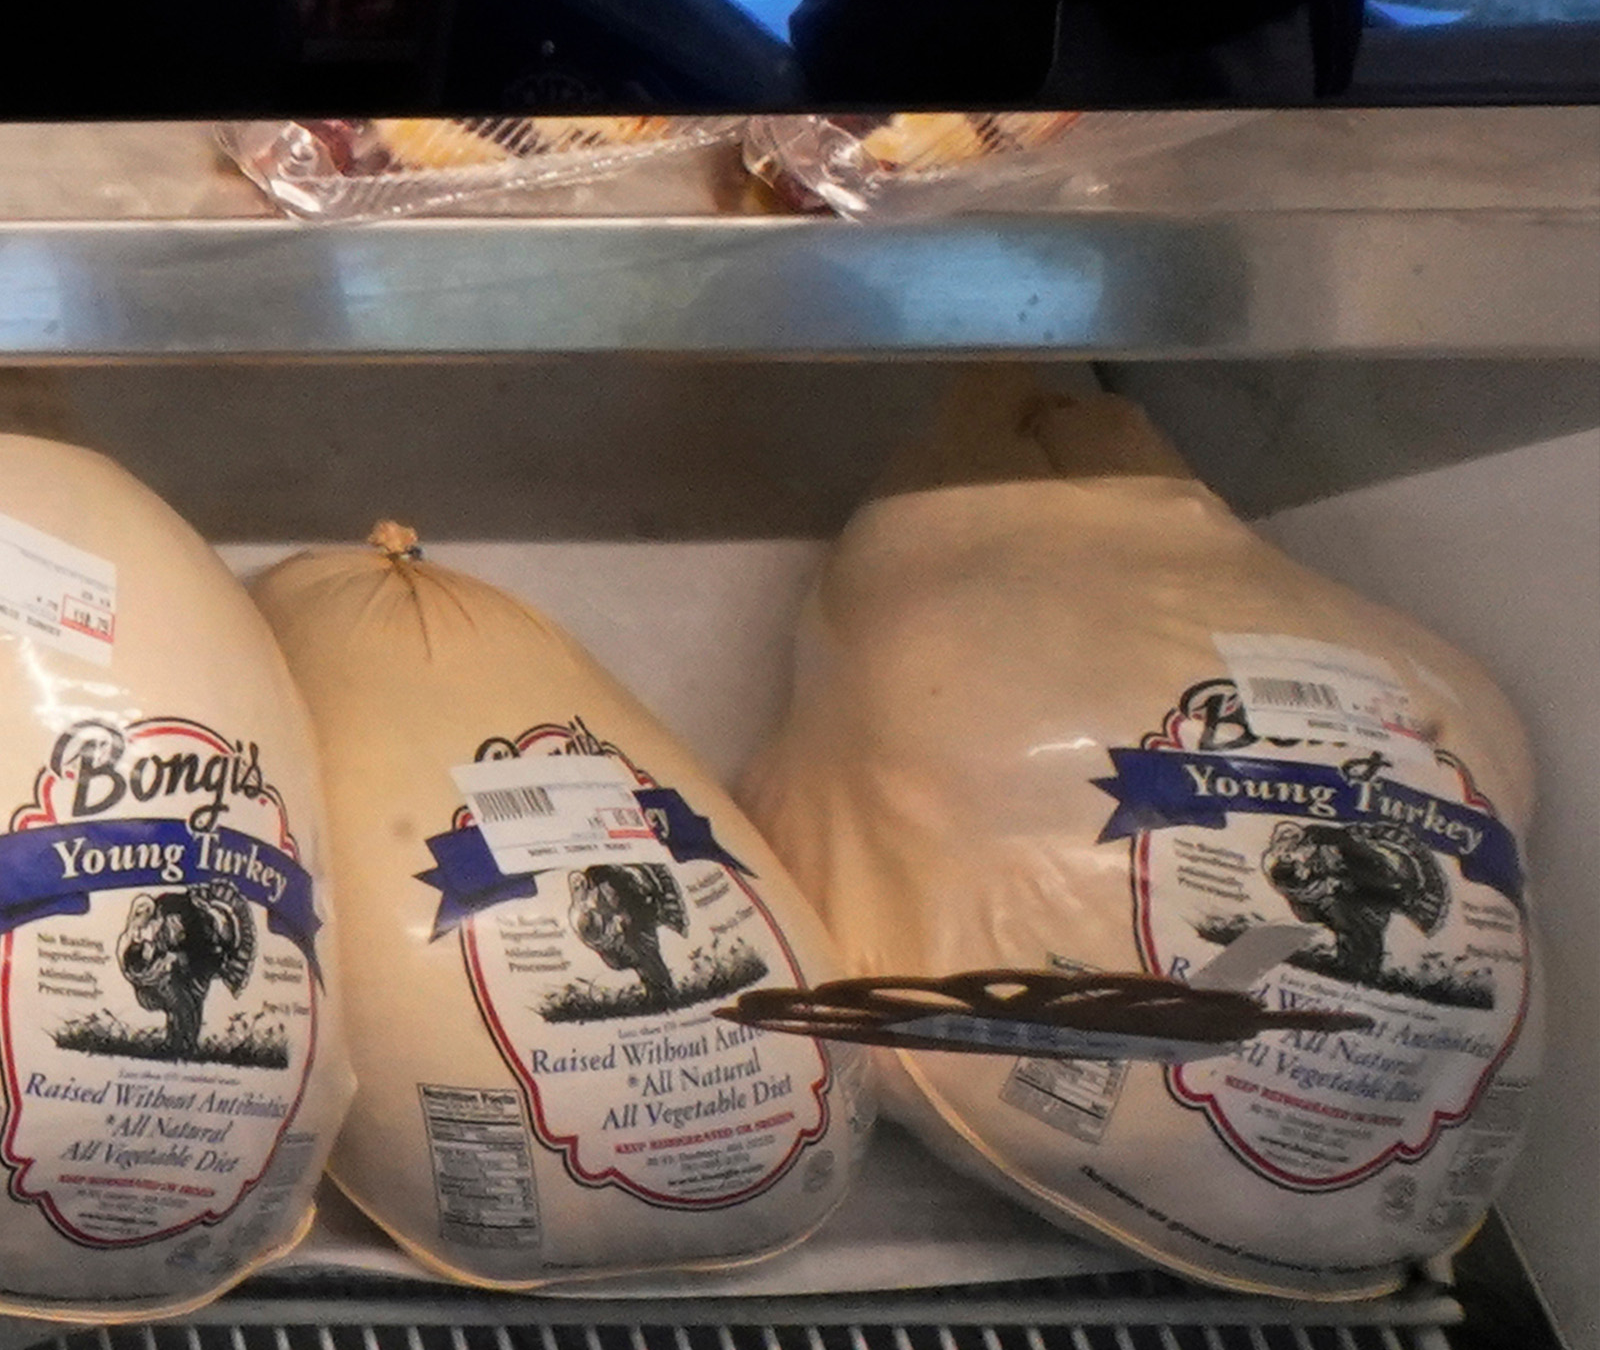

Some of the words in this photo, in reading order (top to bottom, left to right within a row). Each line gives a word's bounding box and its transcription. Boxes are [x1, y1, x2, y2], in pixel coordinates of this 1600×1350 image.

[1184, 762, 1338, 818] Young
[1349, 777, 1485, 855] Turkey
[52, 836, 186, 882] Young
[194, 831, 288, 902] Turkey
[531, 1045, 615, 1073] Raised
[620, 1035, 709, 1068] Without
[680, 1046, 762, 1088] Natural
[25, 1072, 111, 1105] Raised
[114, 1082, 195, 1110] Without
[601, 1103, 638, 1130] All
[644, 1086, 747, 1129] Vegetable
[752, 1074, 793, 1106] Diet
[156, 1117, 234, 1143] Natural
[60, 1140, 102, 1162] All
[194, 1150, 240, 1173] Diet
